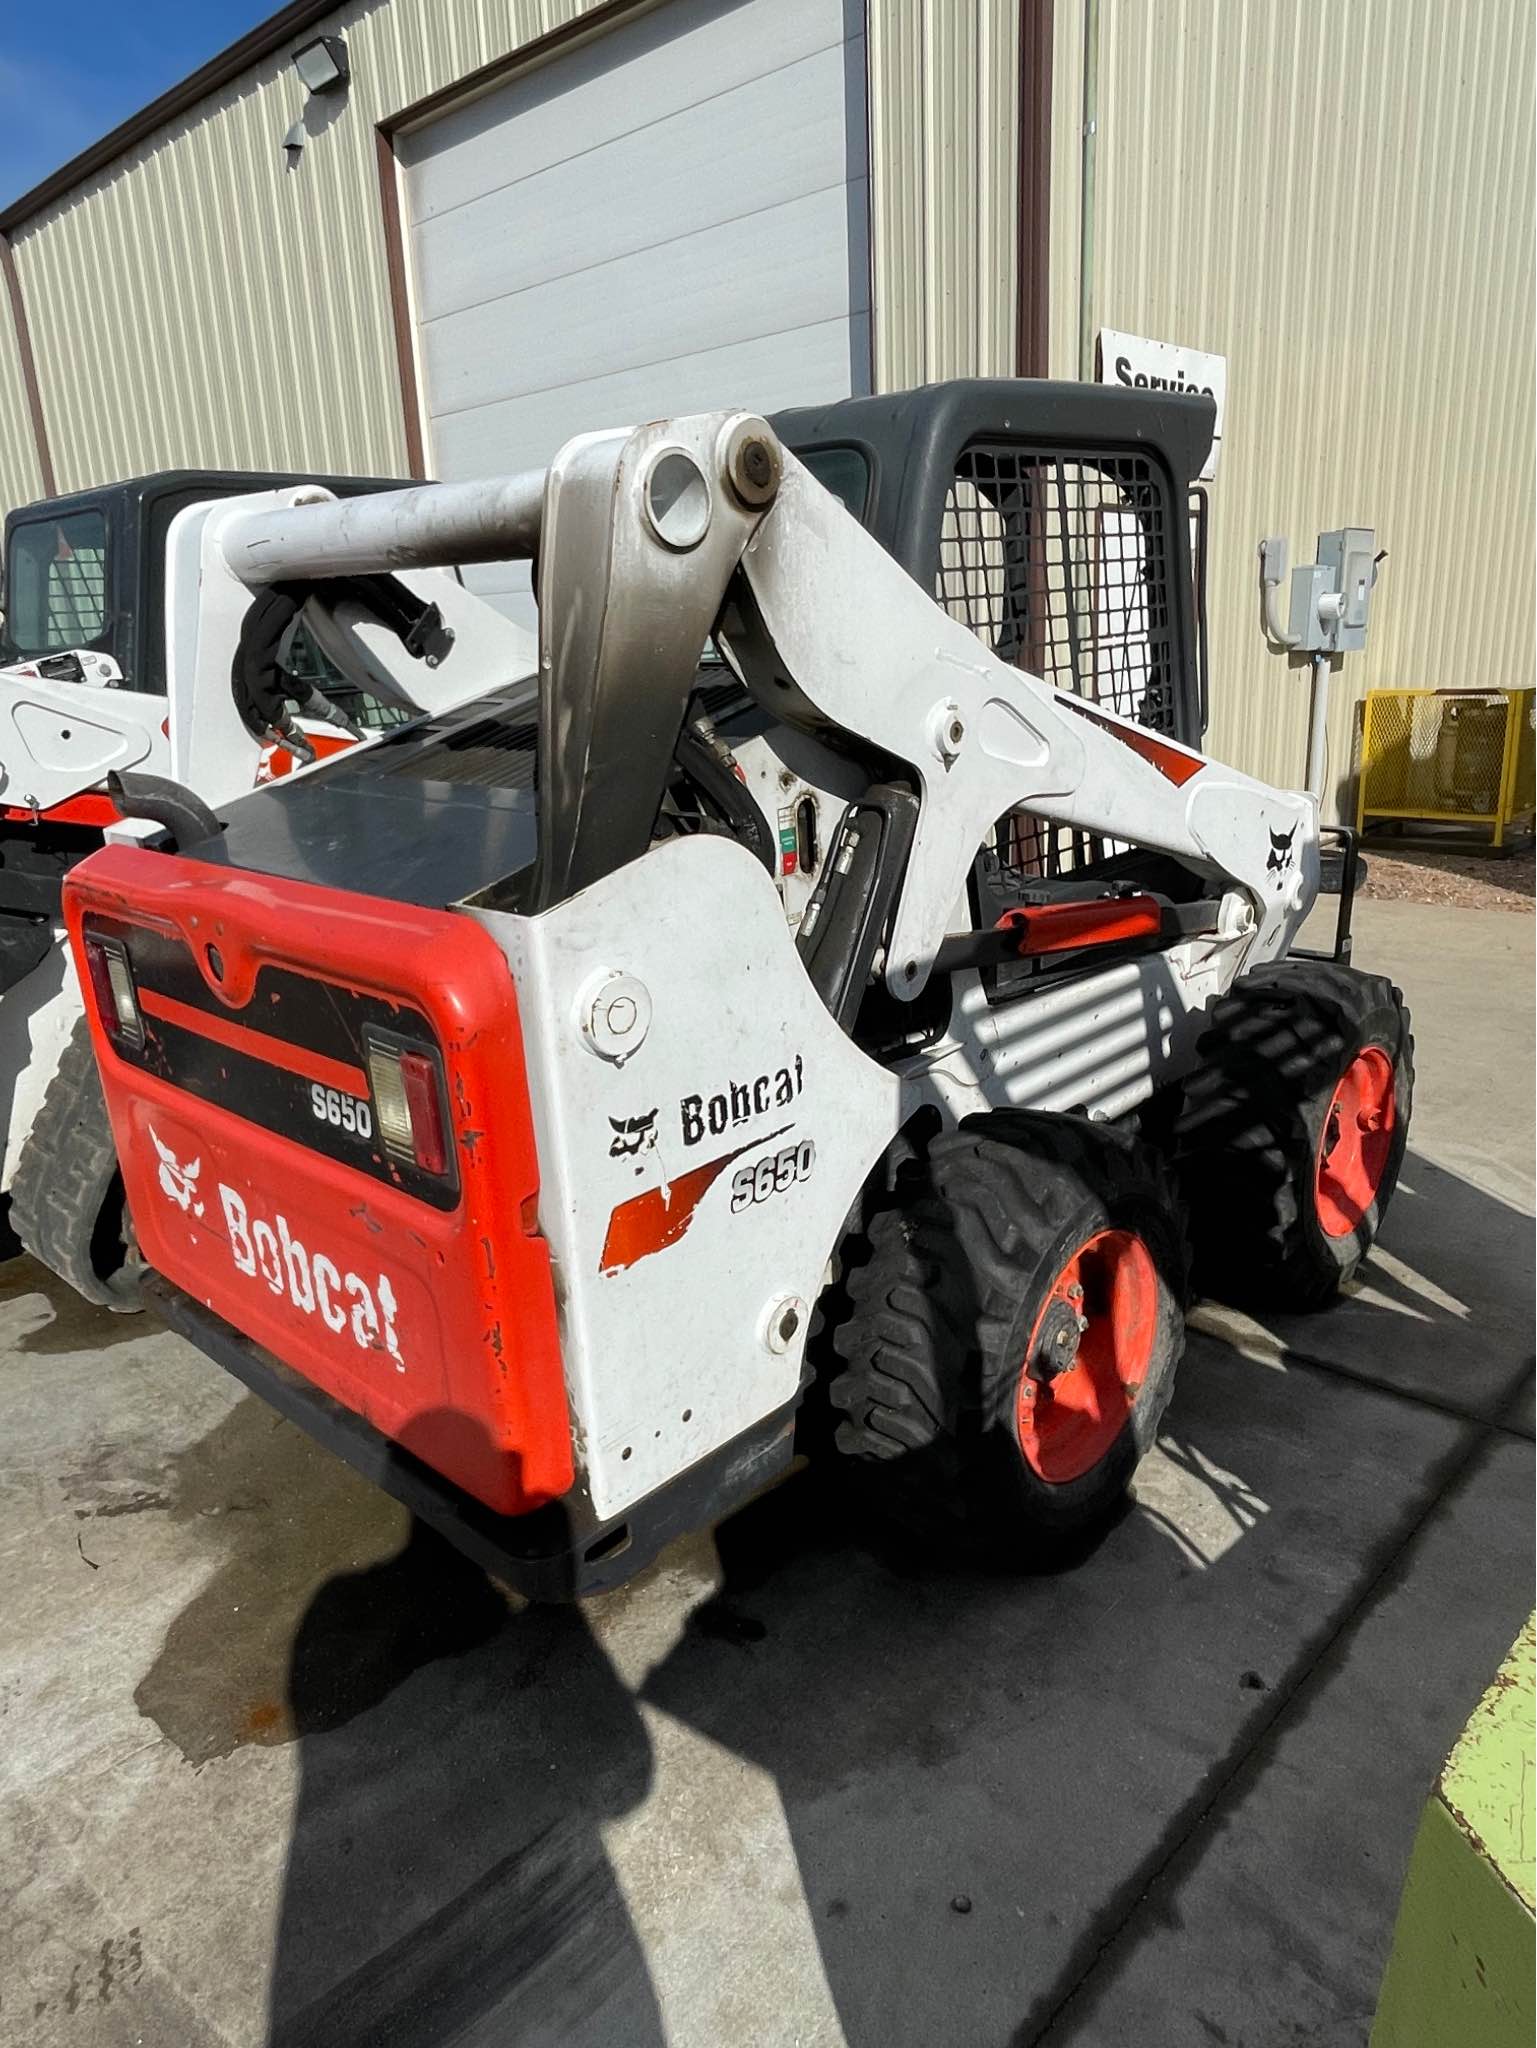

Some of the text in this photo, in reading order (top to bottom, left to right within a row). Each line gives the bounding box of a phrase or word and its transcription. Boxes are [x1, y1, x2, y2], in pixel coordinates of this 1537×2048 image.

[310, 1083, 373, 1139] S650
[680, 1053, 804, 1146] Bobcat
[730, 1139, 817, 1214] S650
[218, 1182, 406, 1373] Bobcat
